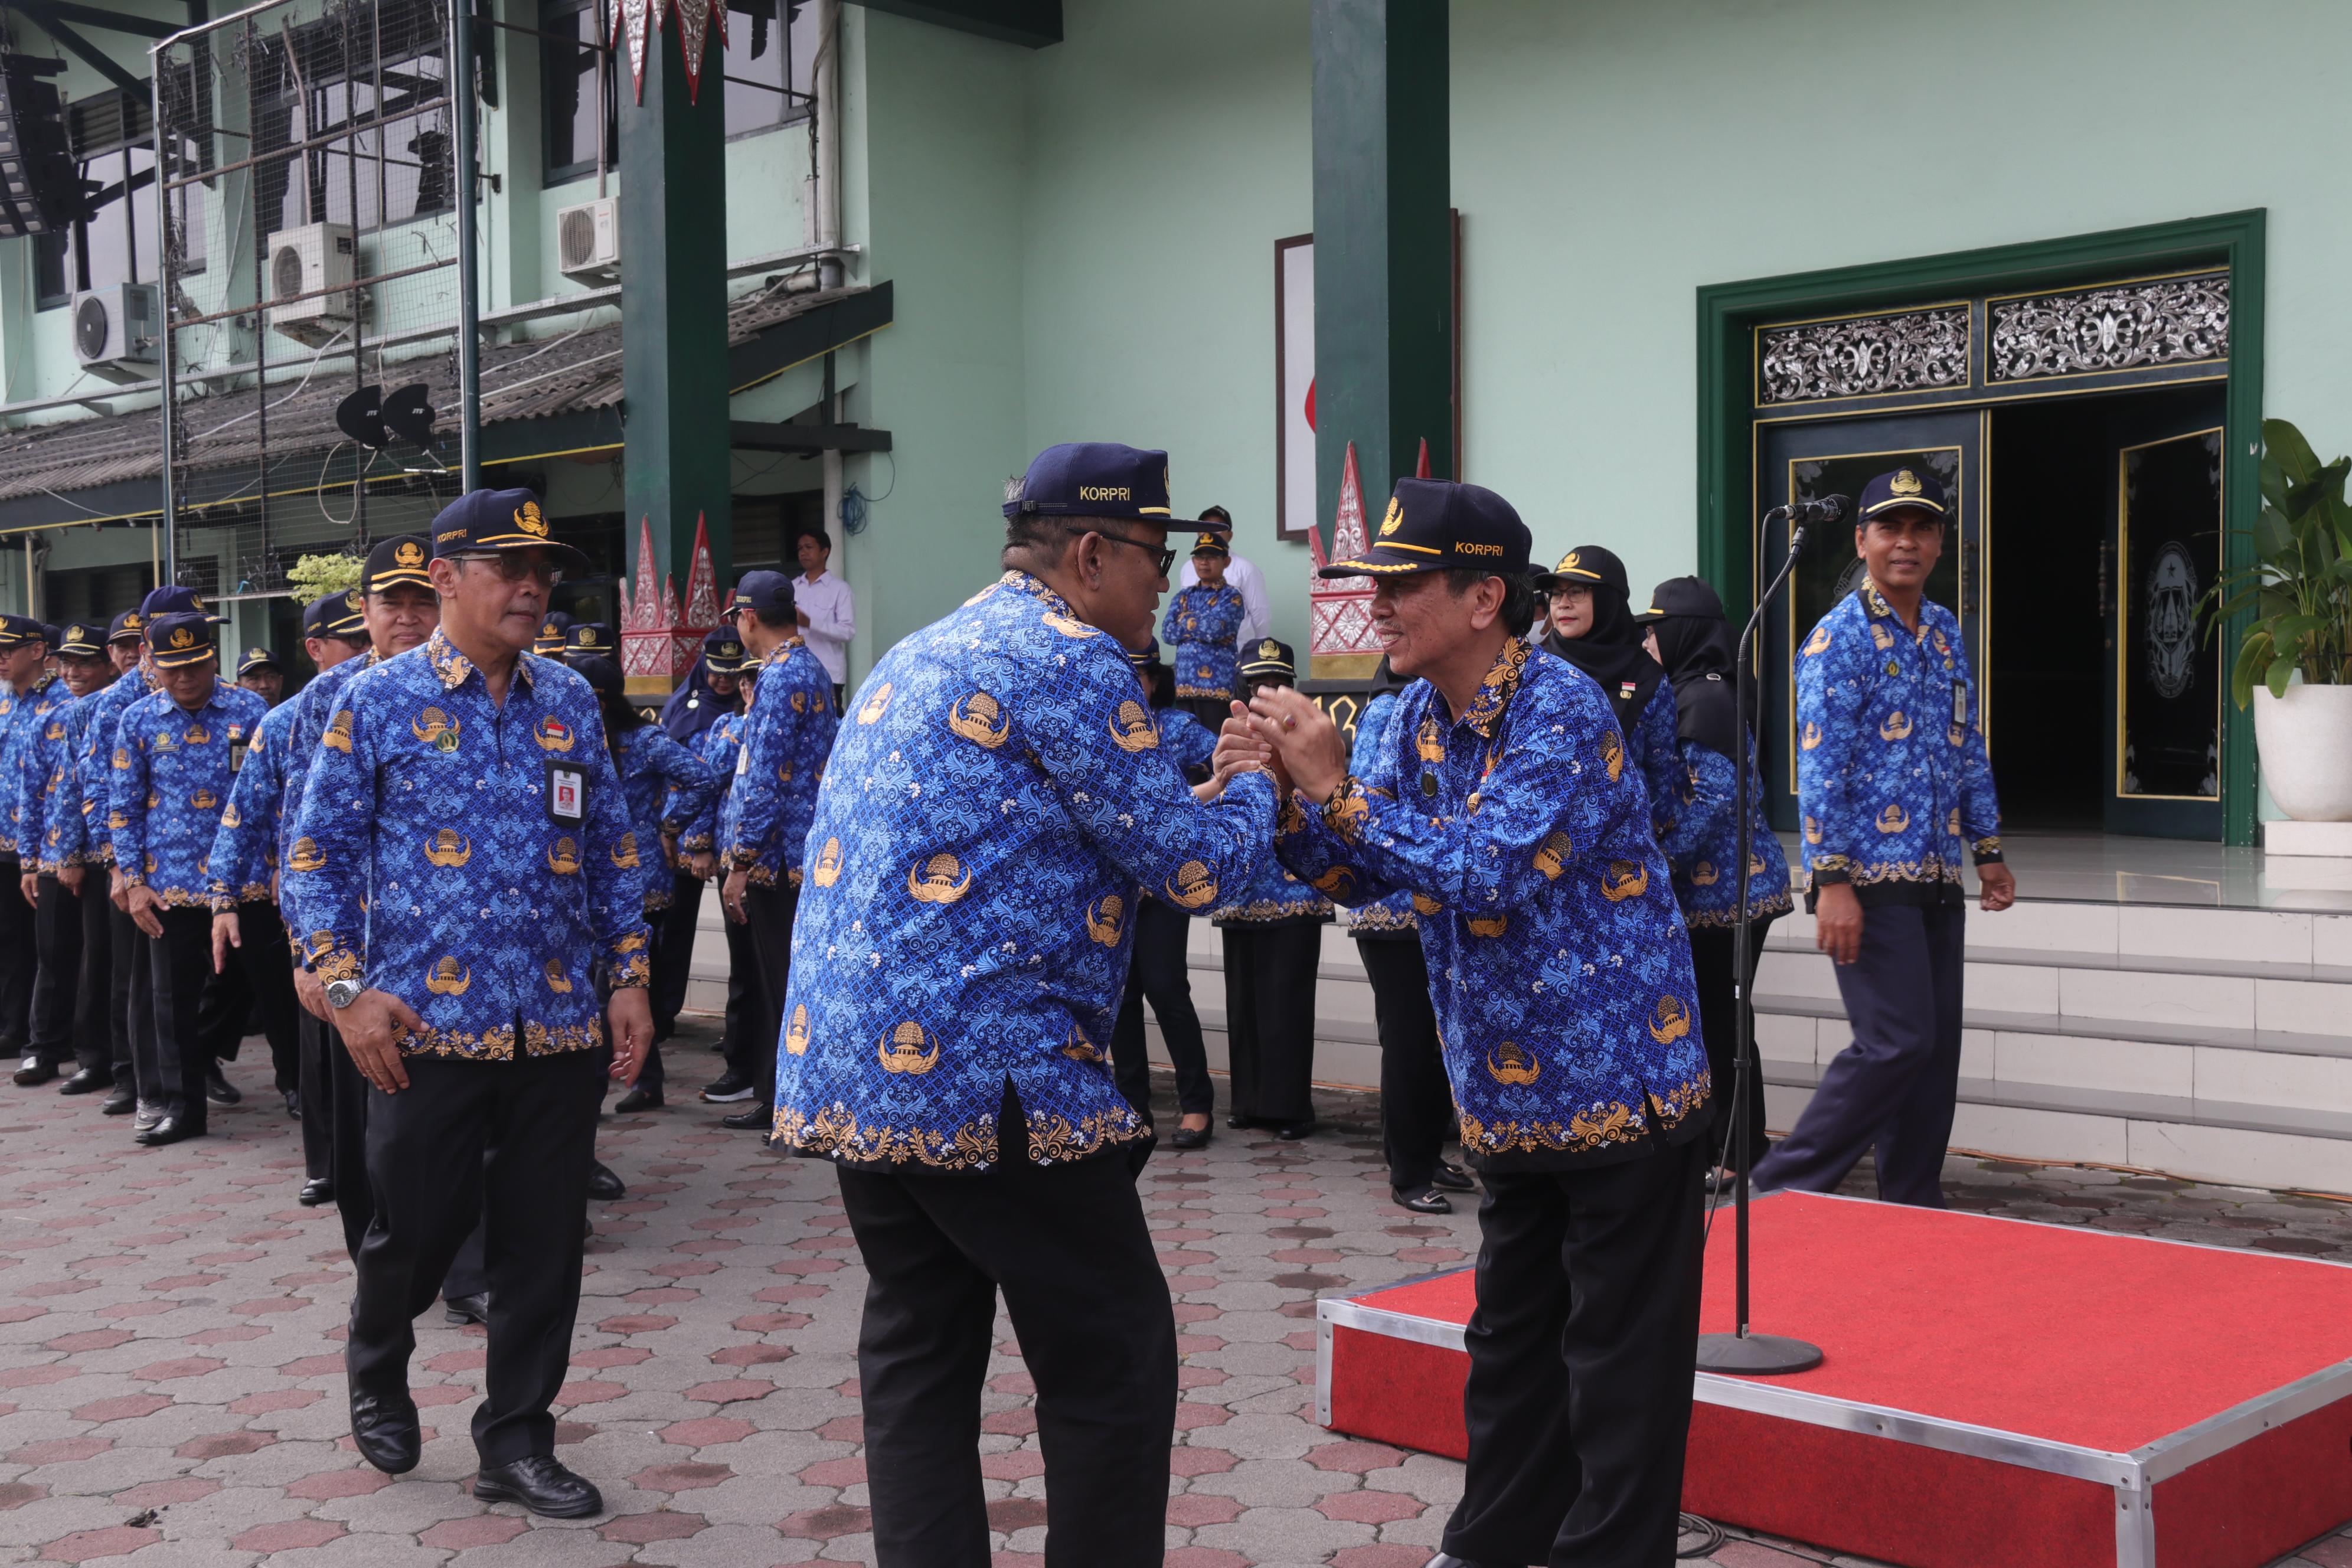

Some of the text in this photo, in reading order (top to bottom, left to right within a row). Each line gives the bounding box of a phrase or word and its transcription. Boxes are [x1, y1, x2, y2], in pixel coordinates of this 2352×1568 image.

[1080, 486, 1130, 501] KORPRI
[437, 528, 467, 543] KORPRI
[1455, 541, 1504, 556] KORPRI
